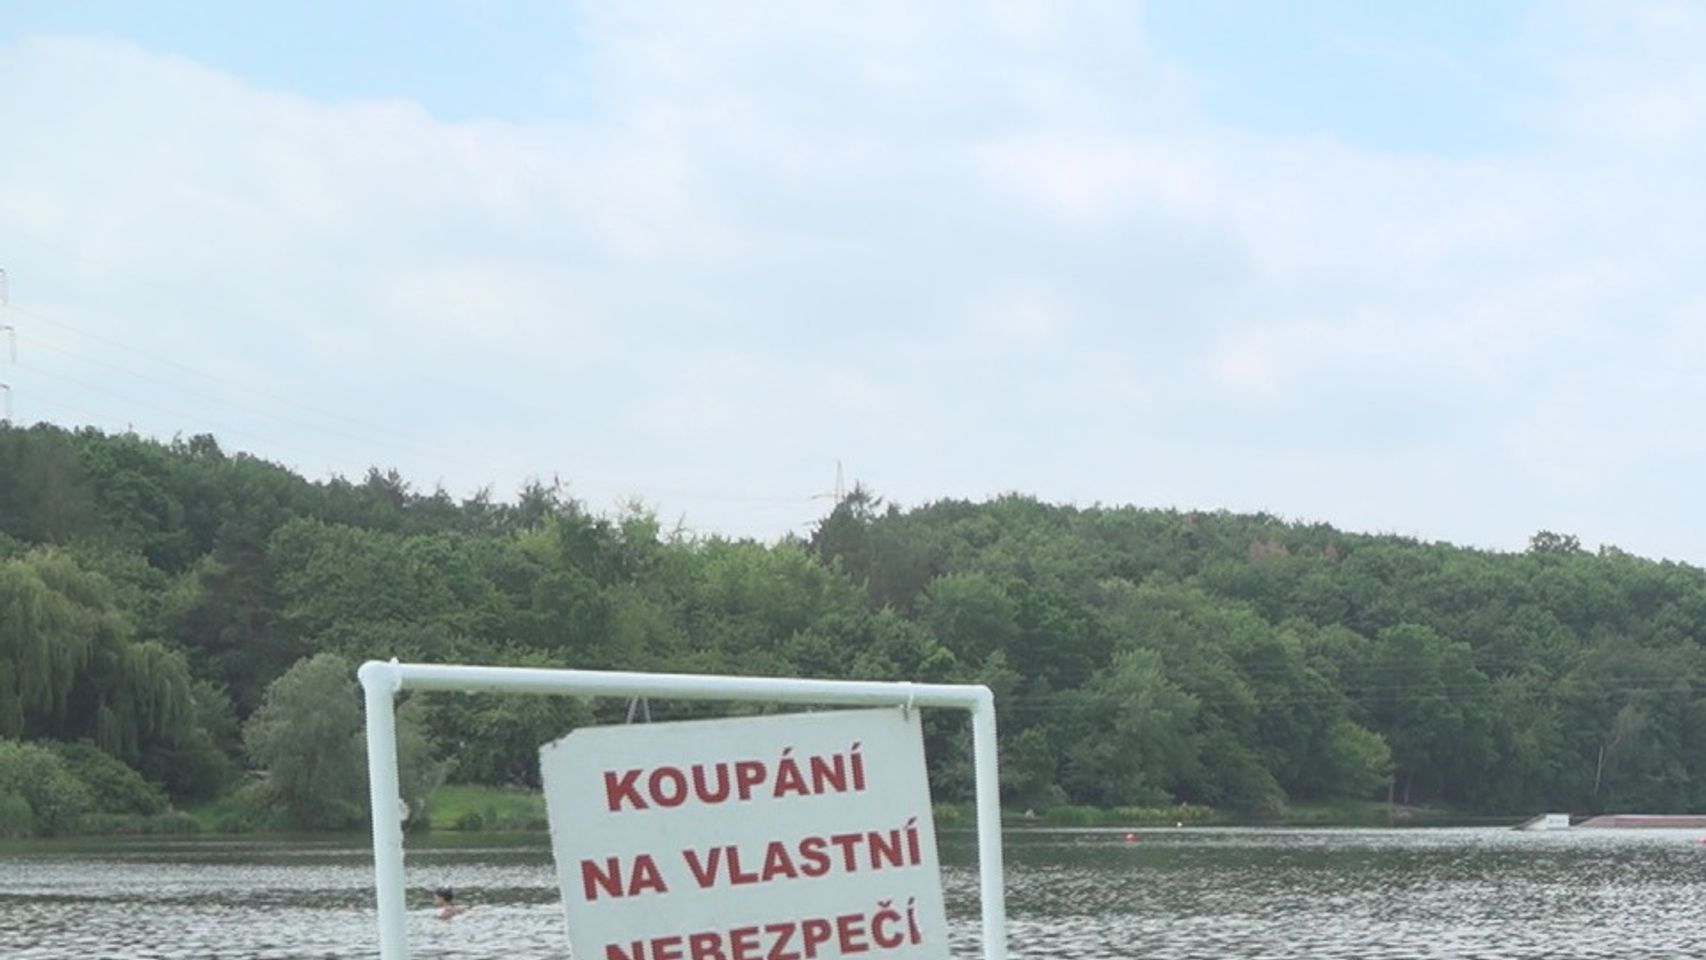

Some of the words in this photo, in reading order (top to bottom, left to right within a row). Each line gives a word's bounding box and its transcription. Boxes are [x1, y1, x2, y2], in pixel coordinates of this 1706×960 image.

[604, 743, 865, 811] KOUPÁNÍ
[581, 855, 667, 900] NA
[683, 817, 921, 888] VLASTNÍ
